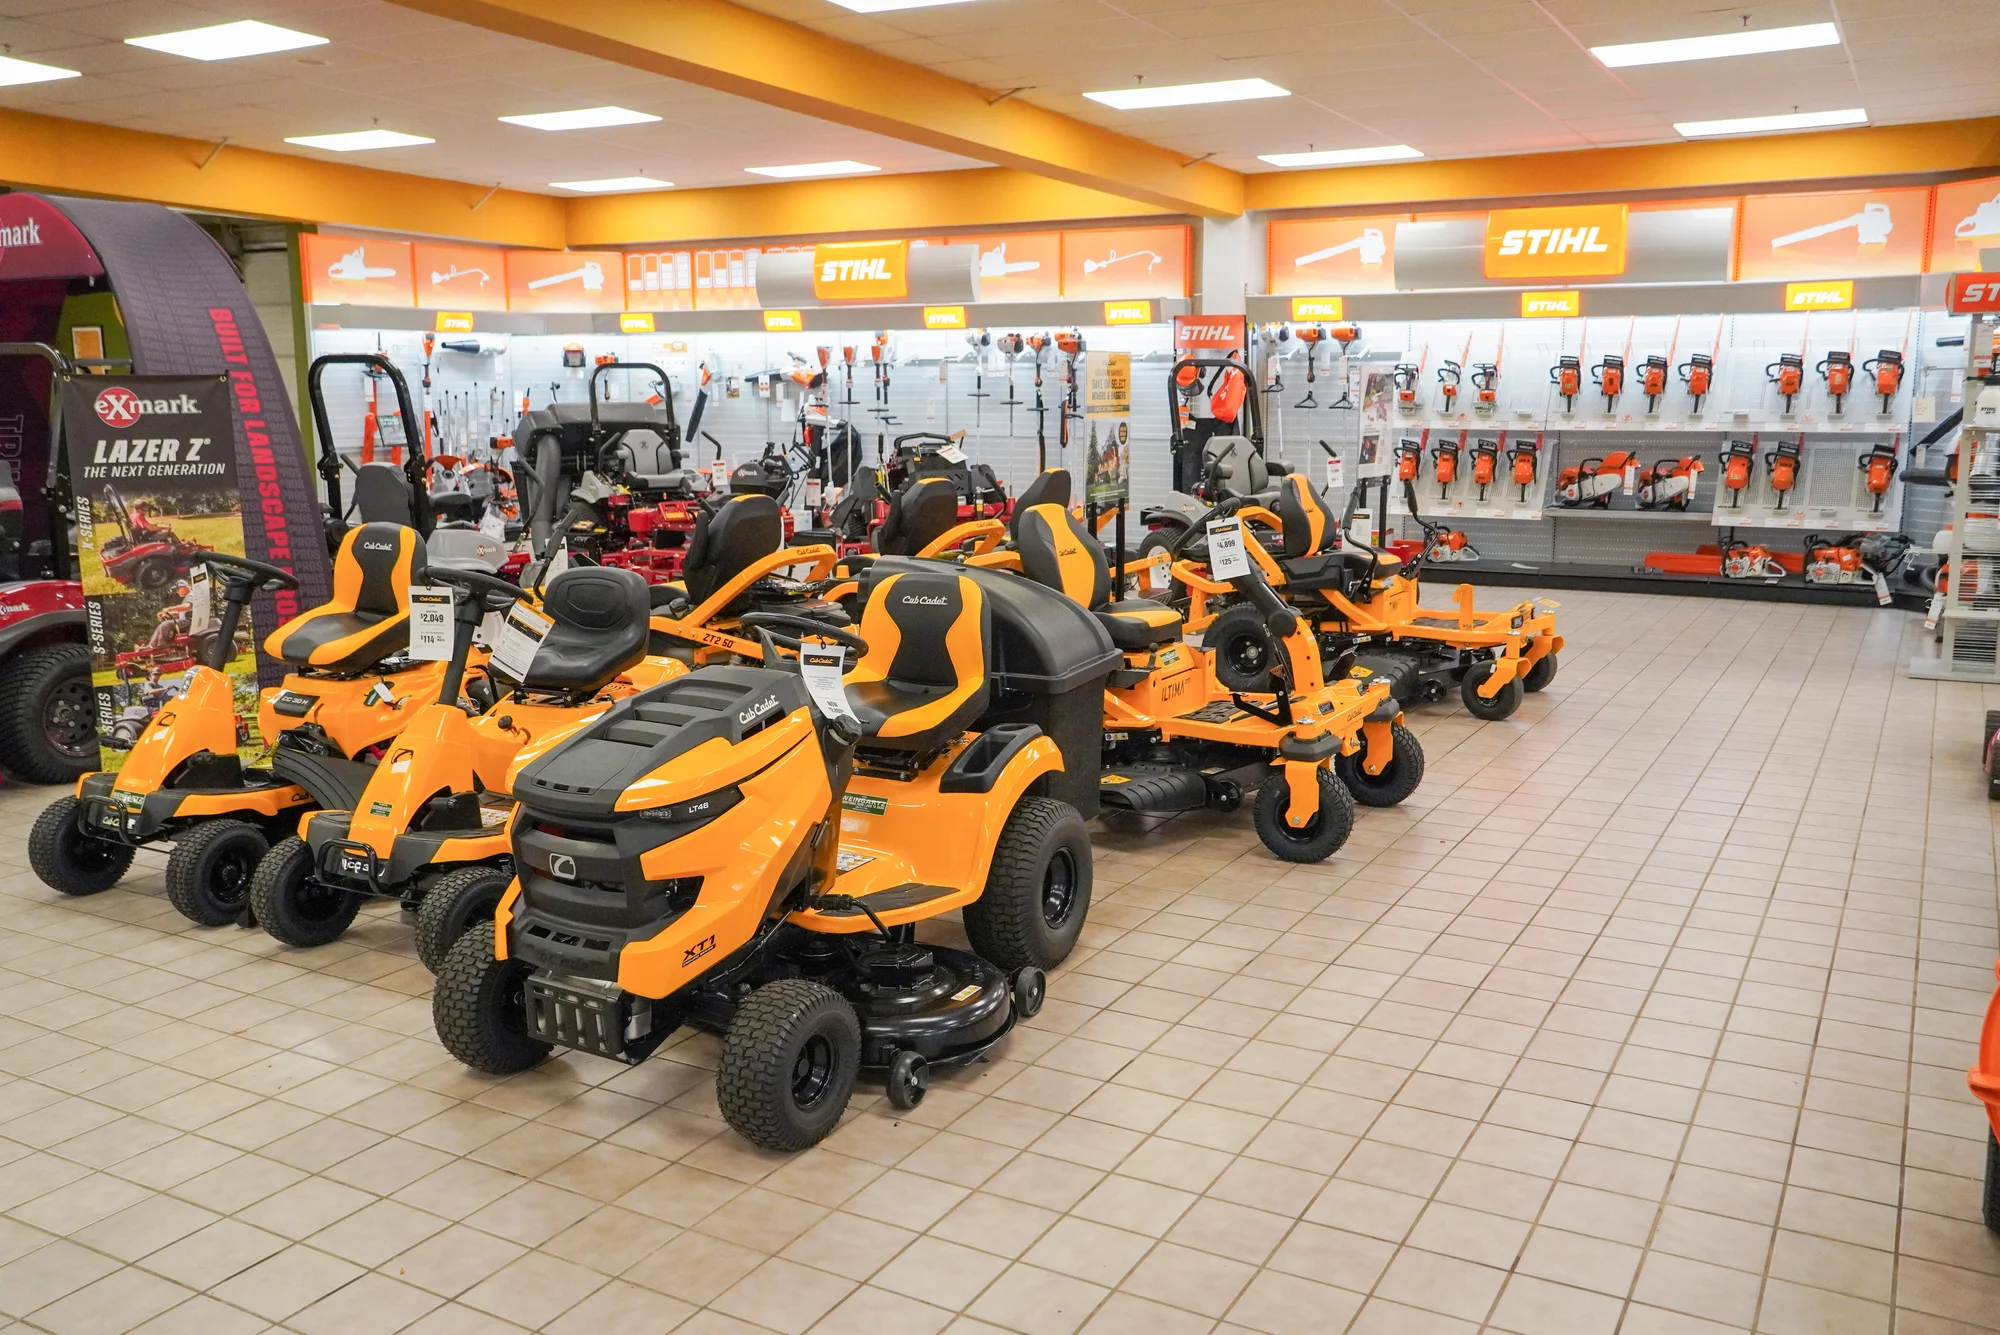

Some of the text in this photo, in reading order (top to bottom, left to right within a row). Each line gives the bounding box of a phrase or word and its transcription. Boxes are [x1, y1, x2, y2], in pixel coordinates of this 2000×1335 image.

[1498, 226, 1608, 256] STIHL
[822, 258, 892, 282] STIHL
[1792, 291, 1844, 305] STIHL
[1298, 303, 1336, 316] STIHL
[1528, 300, 1571, 312] STIHL
[928, 313, 960, 324] STIHL
[1110, 308, 1144, 319] STIHL
[444, 320, 471, 330] STIHL
[624, 320, 648, 328] STIHL
[768, 317, 795, 326] STIHL
[208, 308, 248, 365] BUILT
[1180, 326, 1235, 340] STIHL
[230, 371, 261, 413] FOR
[94, 438, 179, 464] LAZER
[84, 463, 225, 478] THE NEXT GENERATION
[244, 419, 291, 560] LANDSCAPE
[79, 496, 94, 550] X-SERIES
[376, 542, 393, 550] Cadet
[902, 596, 948, 605] Cub Cadet
[420, 613, 444, 623] $2,049
[90, 601, 105, 655] S-SERIES
[703, 633, 734, 648] ZT2 50
[739, 694, 780, 725] Cub Cadet
[683, 934, 715, 962] XT1
